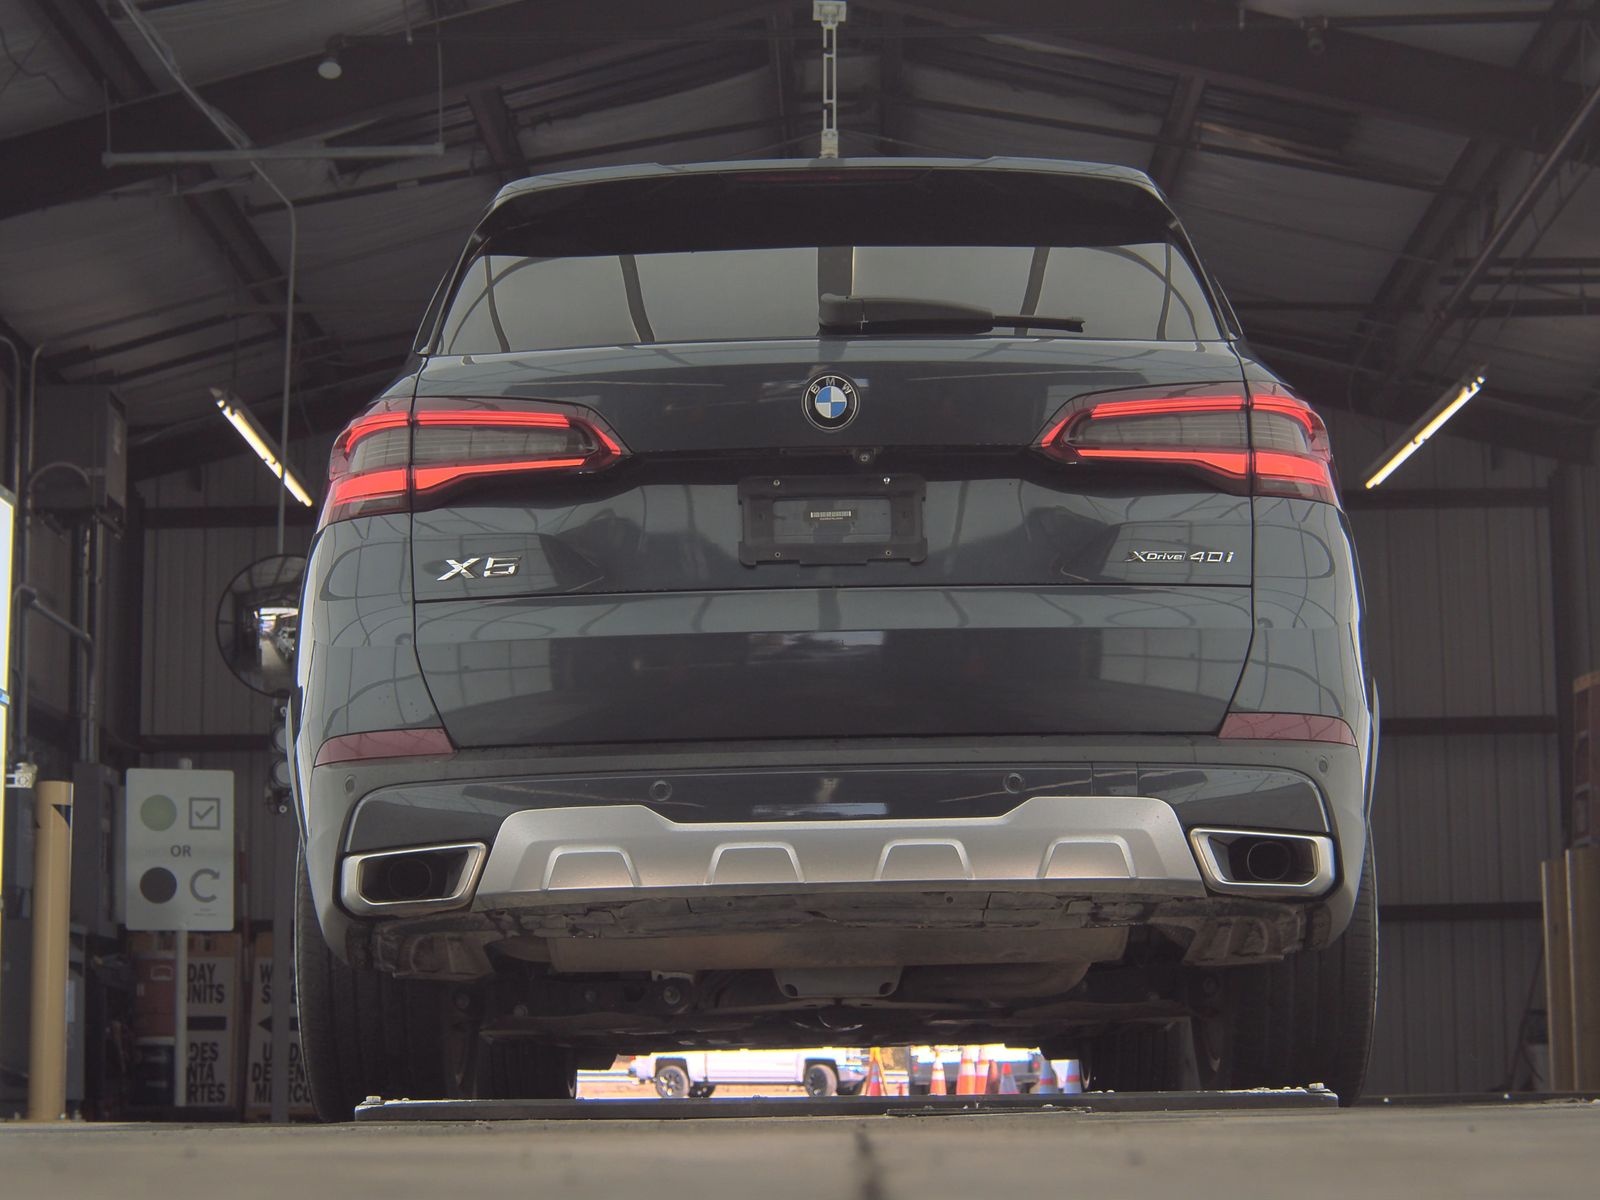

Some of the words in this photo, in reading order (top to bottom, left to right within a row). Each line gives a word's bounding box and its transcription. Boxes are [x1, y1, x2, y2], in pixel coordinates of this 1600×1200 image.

[810, 377, 852, 394] BMW
[437, 557, 519, 580] X5
[170, 845, 192, 858] OR
[188, 1084, 225, 1103] RTES
